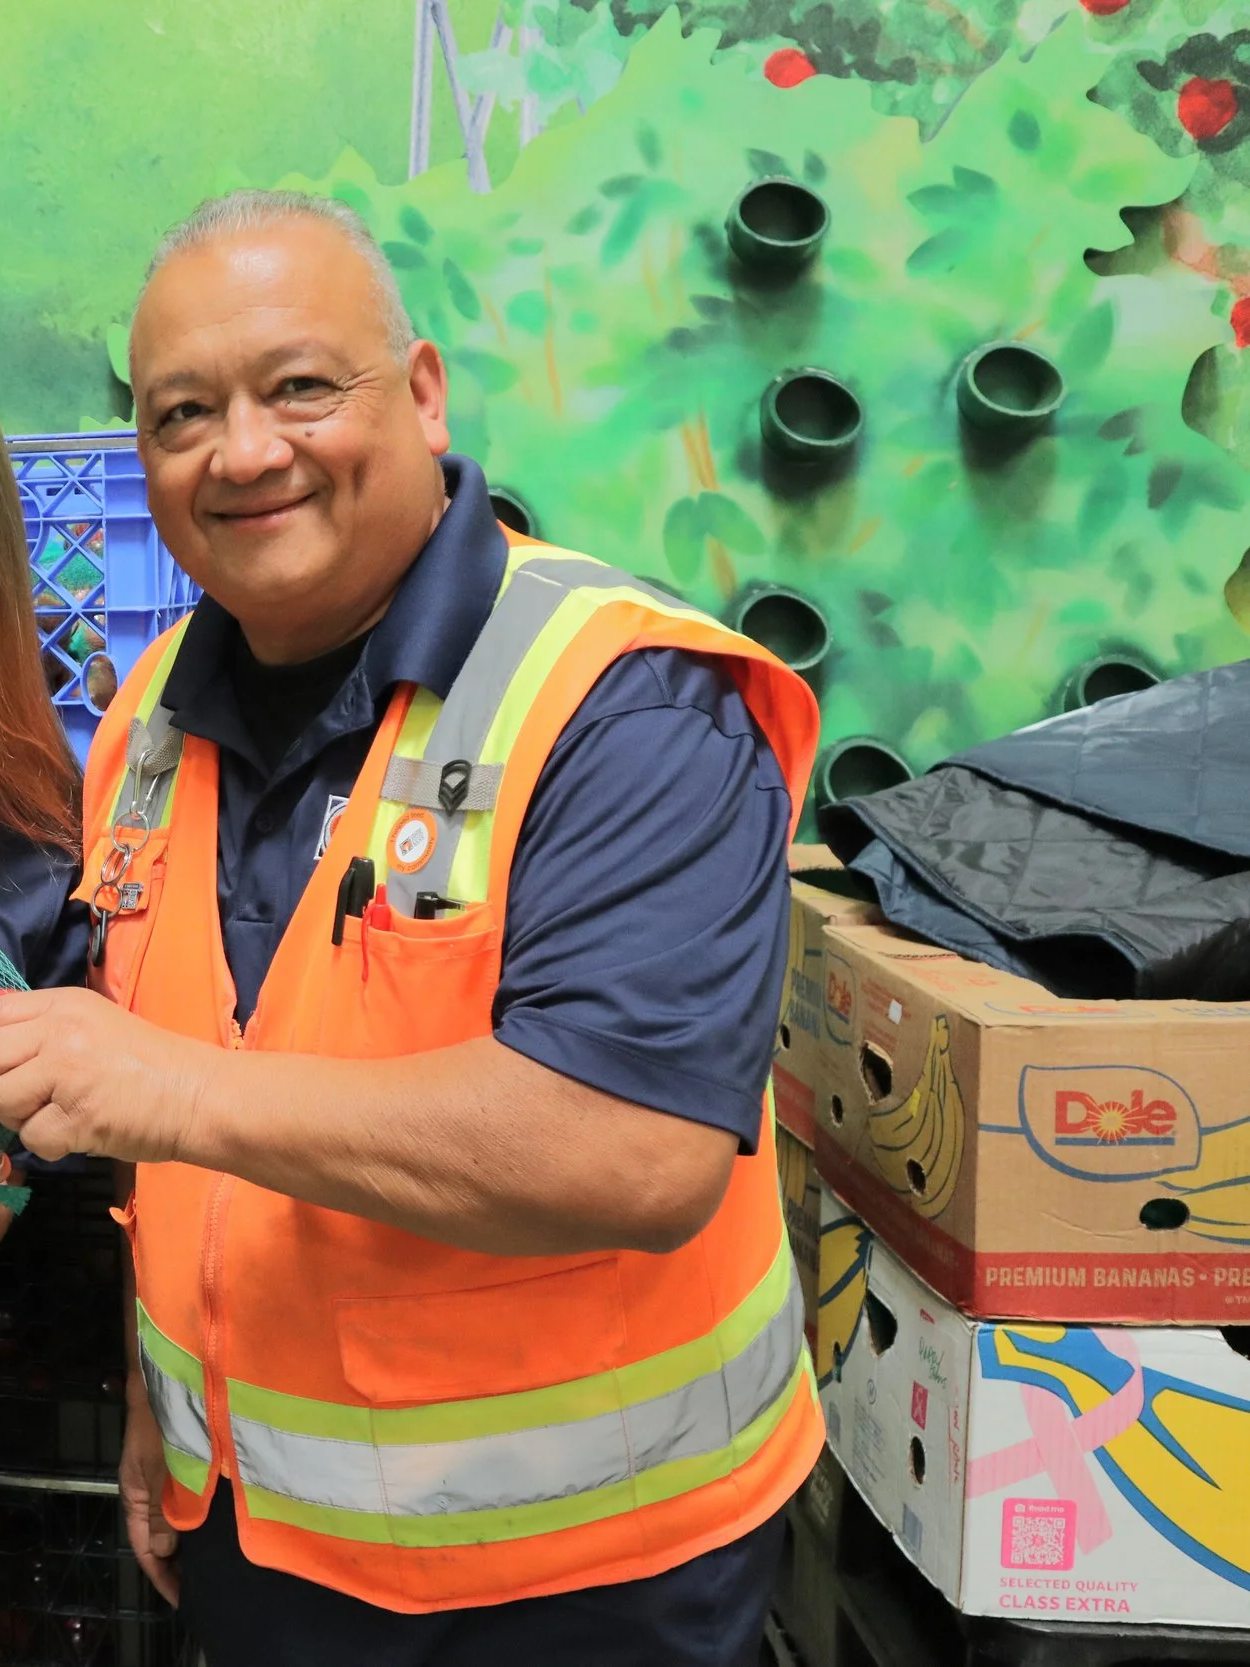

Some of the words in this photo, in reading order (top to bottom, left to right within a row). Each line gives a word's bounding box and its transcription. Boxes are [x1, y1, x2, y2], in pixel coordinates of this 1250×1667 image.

[1055, 1089, 1177, 1142] Dole
[986, 1267, 1087, 1288] PREMIUM
[1093, 1267, 1196, 1288] BANANAS
[999, 1577, 1071, 1590] SELECTED
[1075, 1580, 1138, 1593] QUALITY
[999, 1594, 1061, 1611] CLASS
[1065, 1597, 1130, 1613] EXTRA
